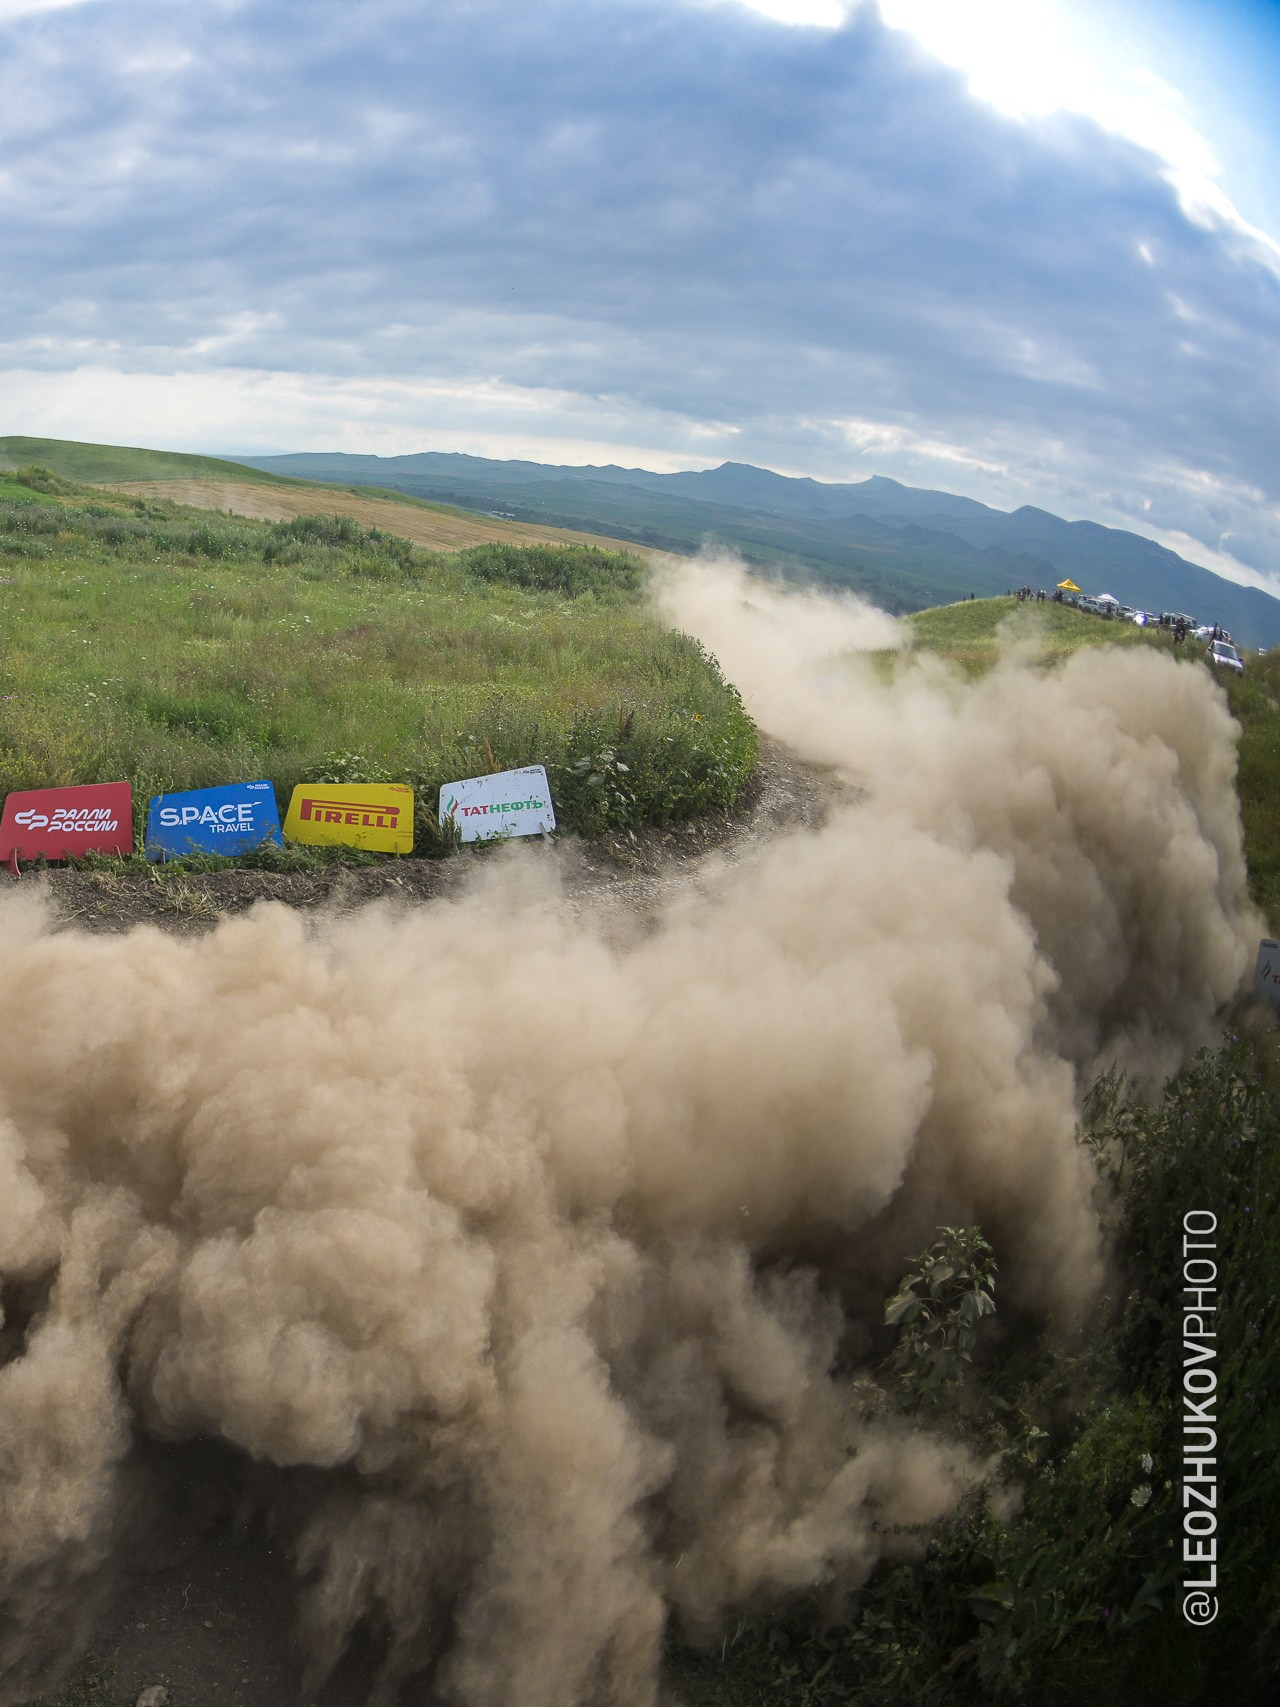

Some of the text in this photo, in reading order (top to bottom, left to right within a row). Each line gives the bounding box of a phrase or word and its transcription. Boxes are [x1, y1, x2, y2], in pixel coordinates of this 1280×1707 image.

[52, 808, 111, 820] РАЛЛИ
[160, 803, 254, 827] SPACE
[300, 798, 400, 829] PIRELLI
[461, 800, 543, 817] ТАТНЕФТЬ
[47, 820, 118, 832] РОССИИ
[209, 822, 254, 834] TRAVEL
